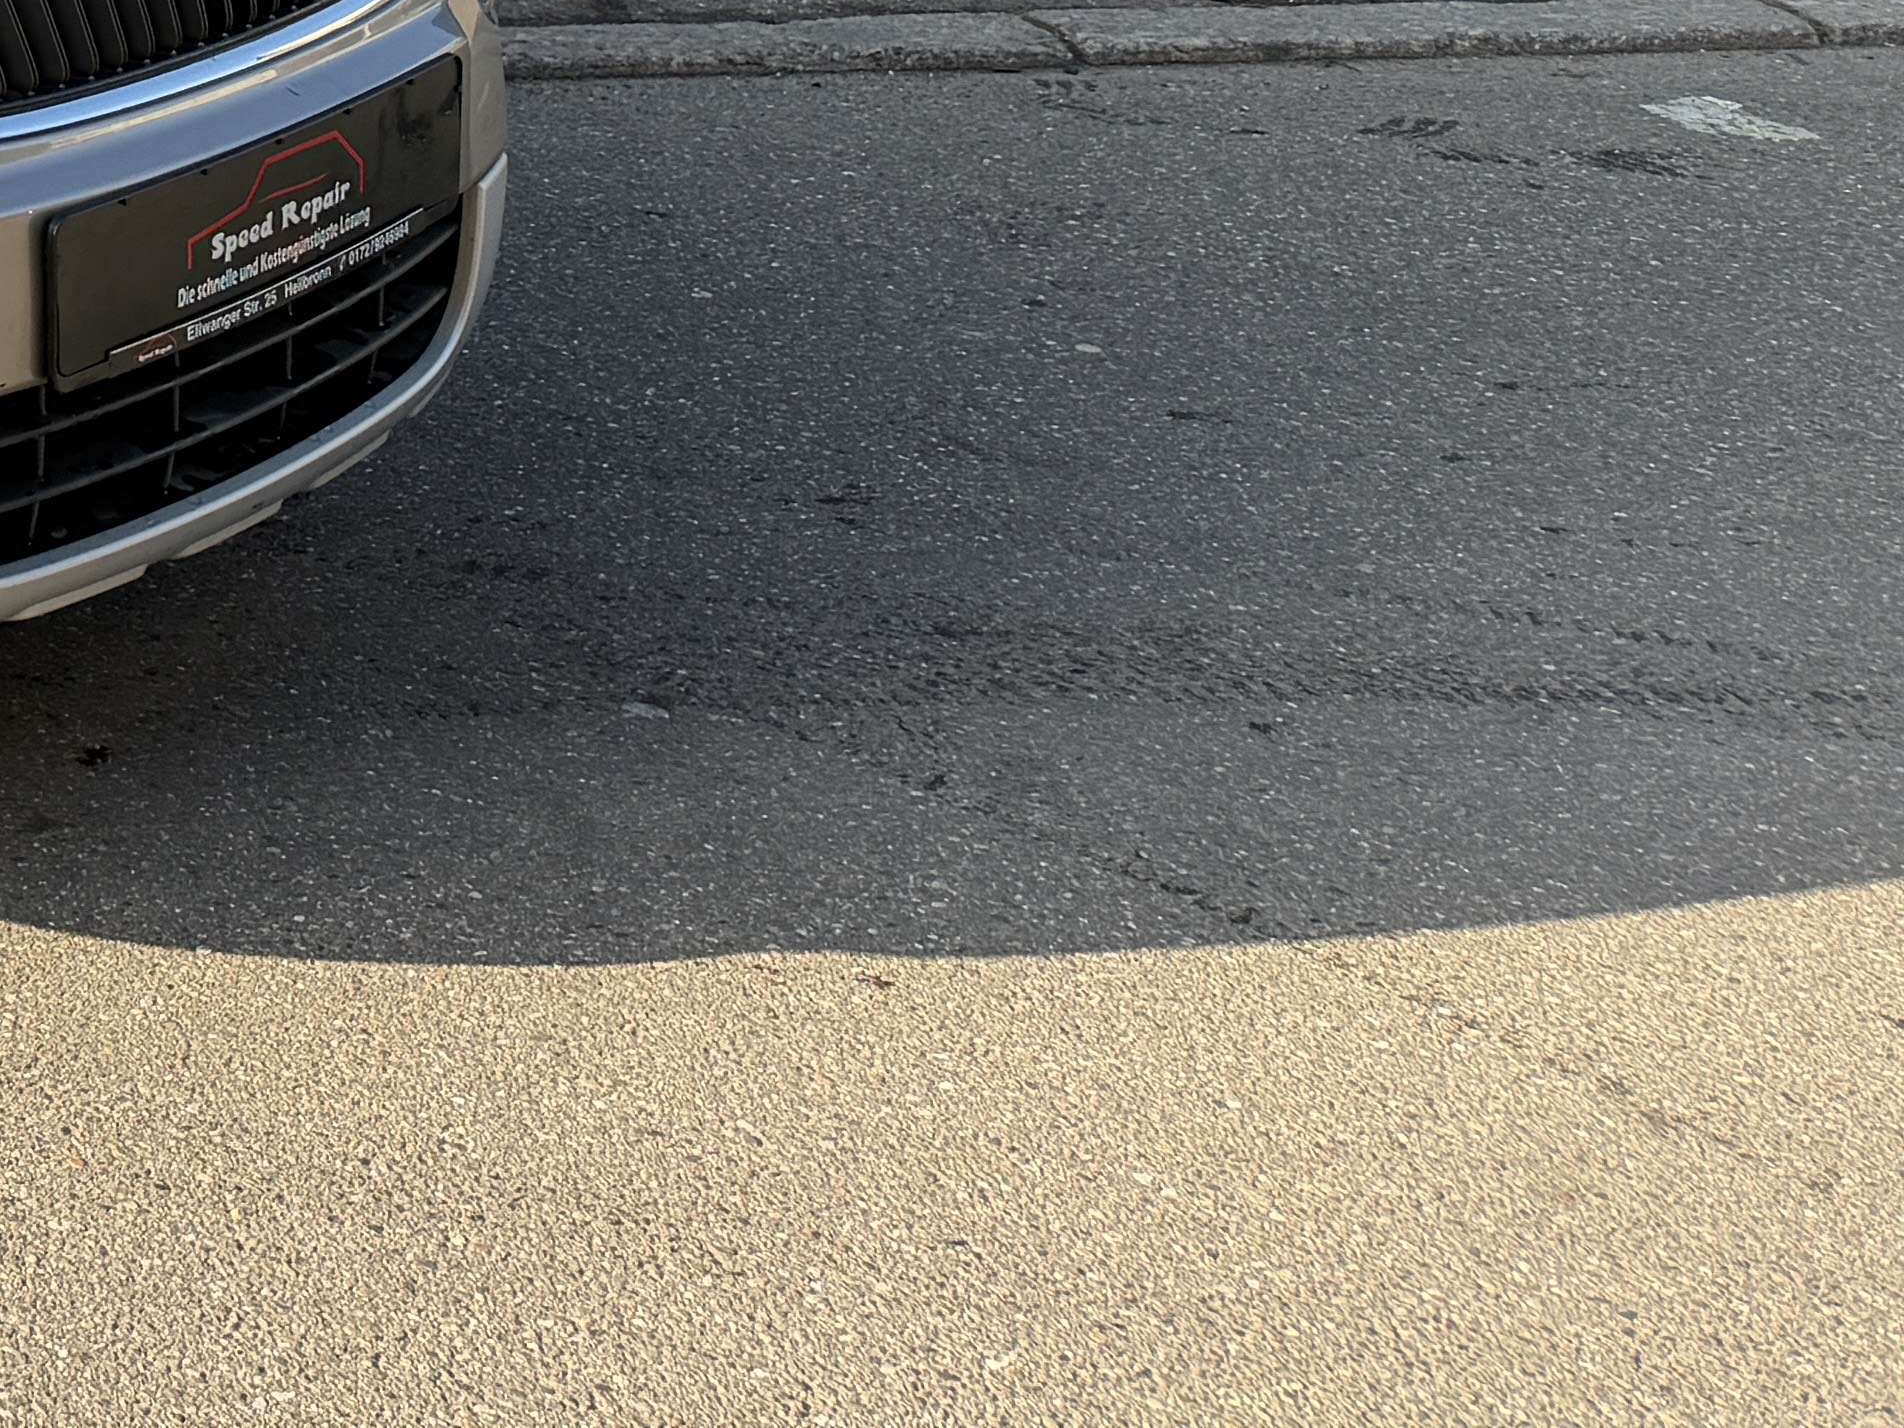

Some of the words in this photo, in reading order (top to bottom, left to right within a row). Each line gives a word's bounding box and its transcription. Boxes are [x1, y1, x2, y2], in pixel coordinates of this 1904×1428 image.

[211, 211, 273, 262] Speed
[281, 181, 351, 230] Repair
[177, 285, 195, 308] Die
[197, 266, 239, 300] schnelle
[240, 255, 259, 282] und
